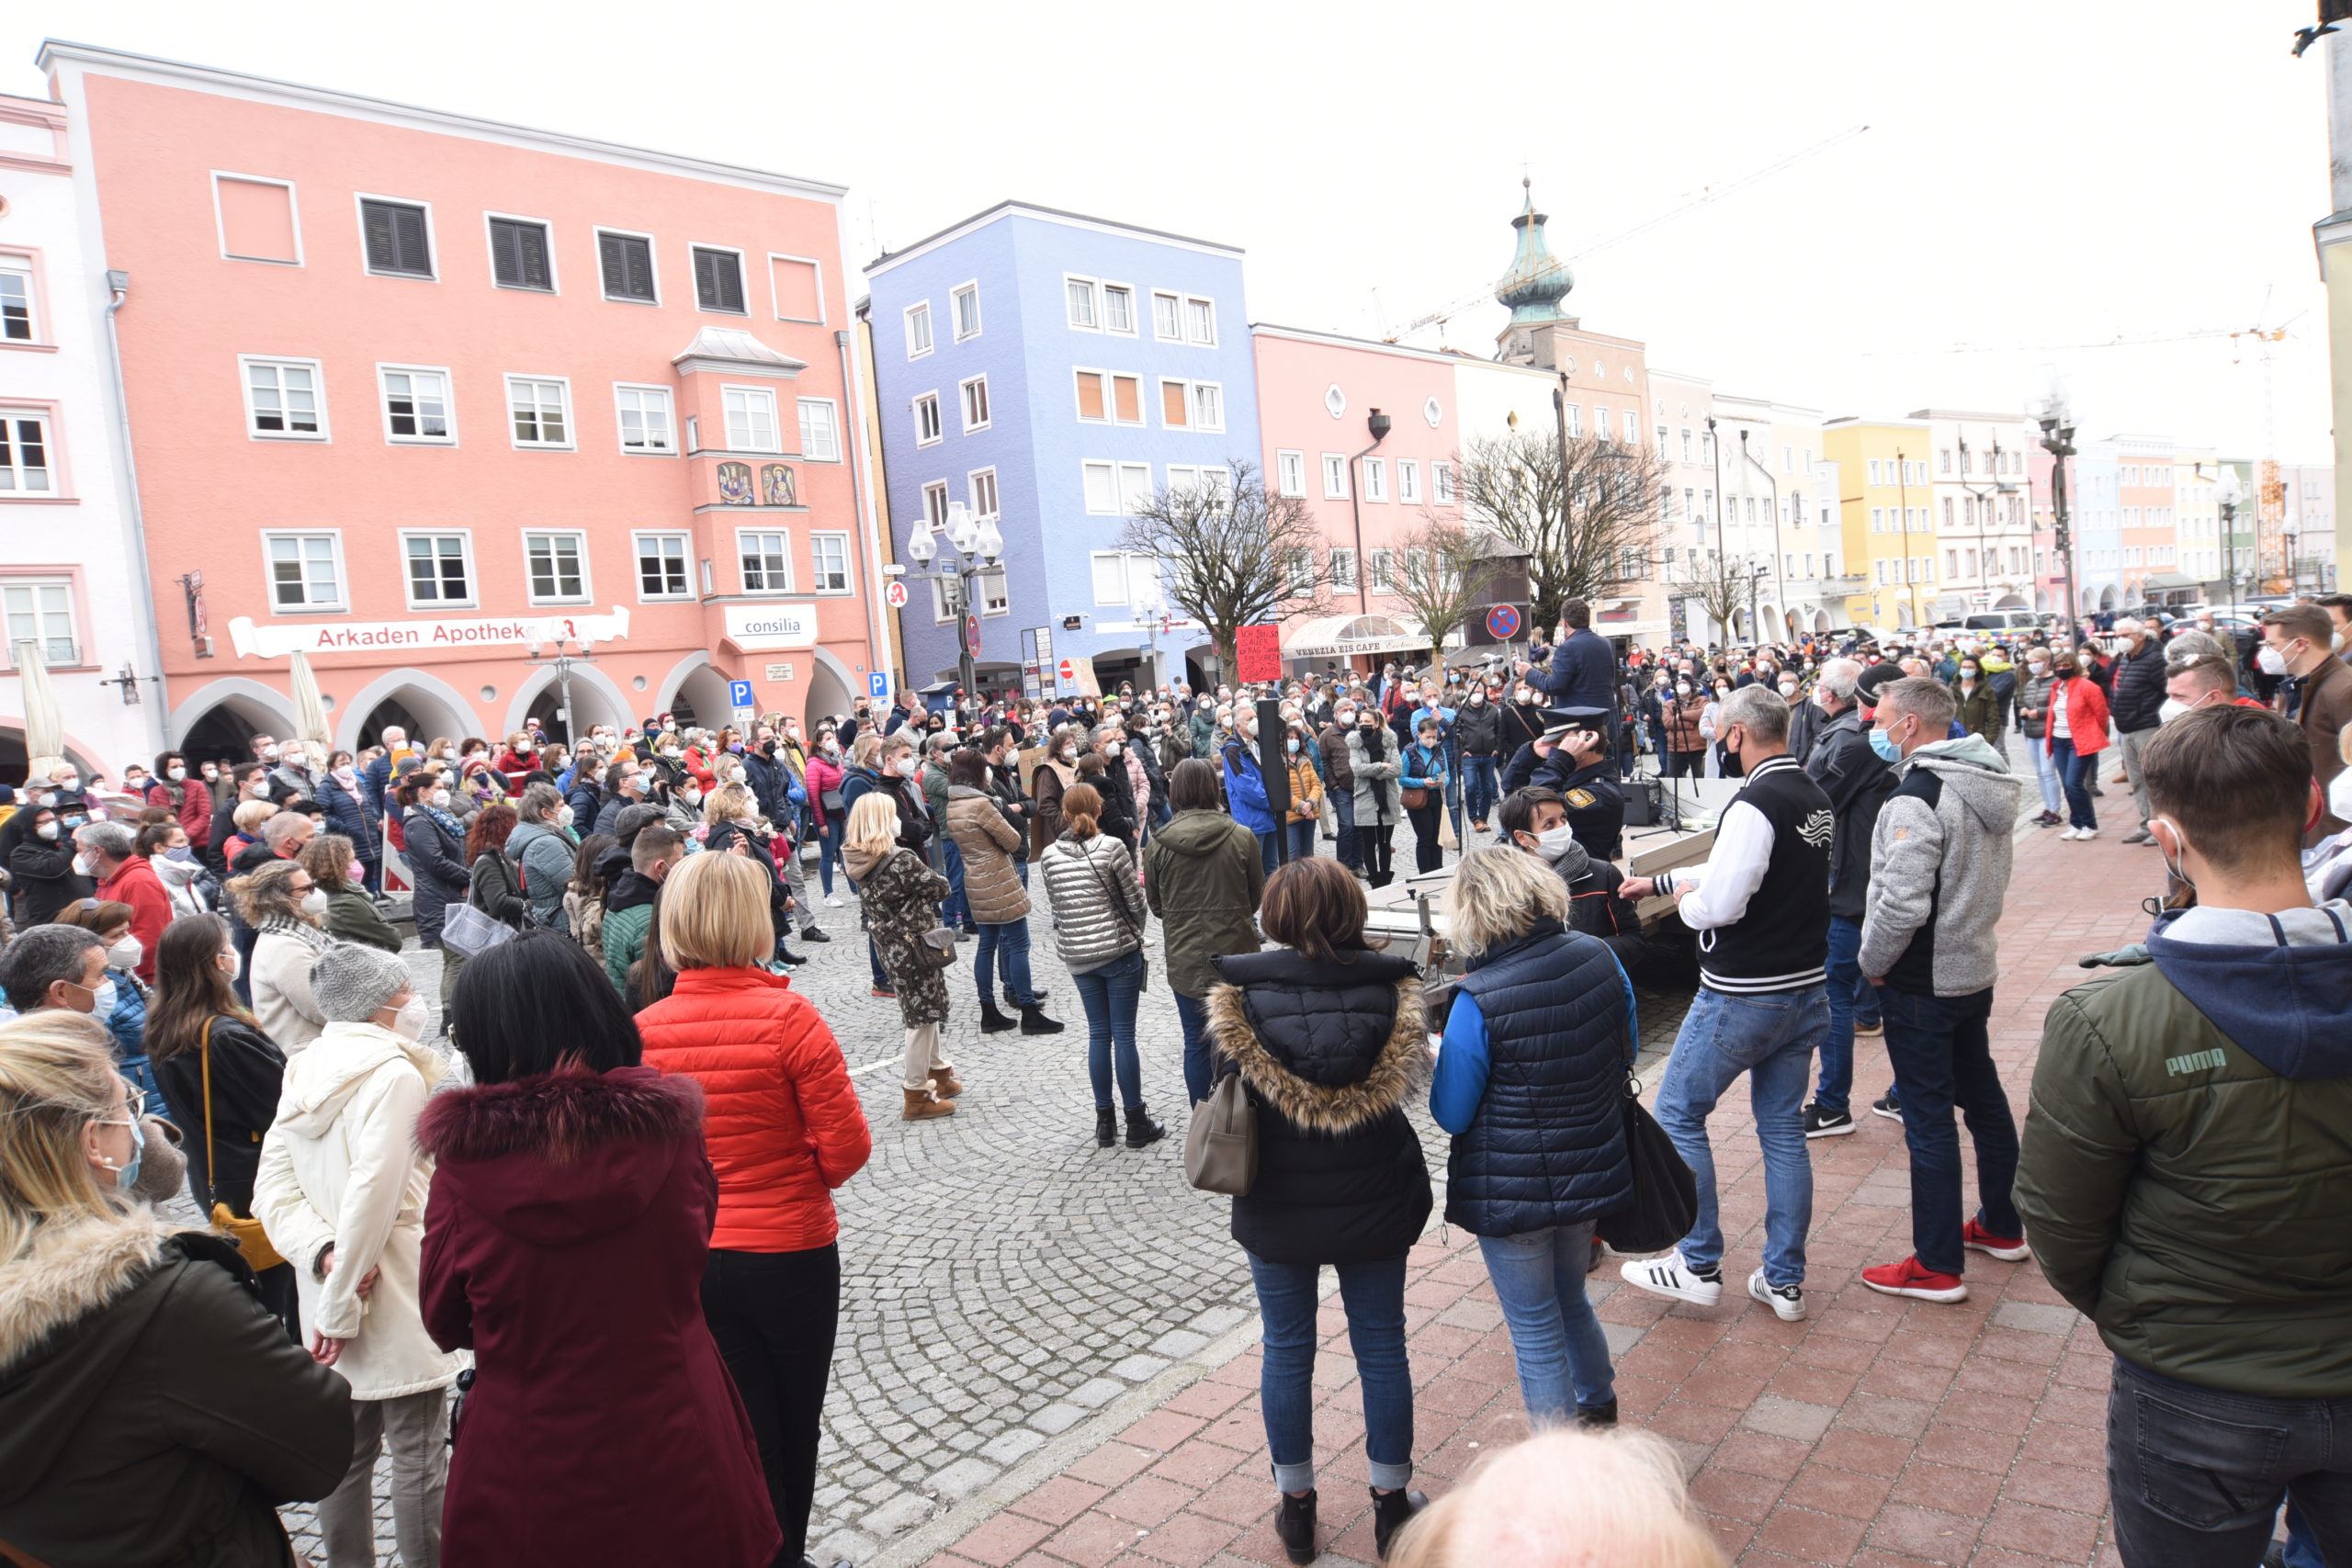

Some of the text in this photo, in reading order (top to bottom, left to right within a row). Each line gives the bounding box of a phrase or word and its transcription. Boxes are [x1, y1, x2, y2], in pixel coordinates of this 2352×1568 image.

[317, 622, 526, 648] Arkaden Apothek
[745, 618, 800, 633] consilia
[1295, 646, 1336, 656] VENEZIA
[1339, 644, 1354, 653] EIS
[1356, 642, 1380, 651] CAFE
[736, 683, 747, 704] P
[873, 675, 883, 694] P
[2165, 1048, 2226, 1077] PUMA
